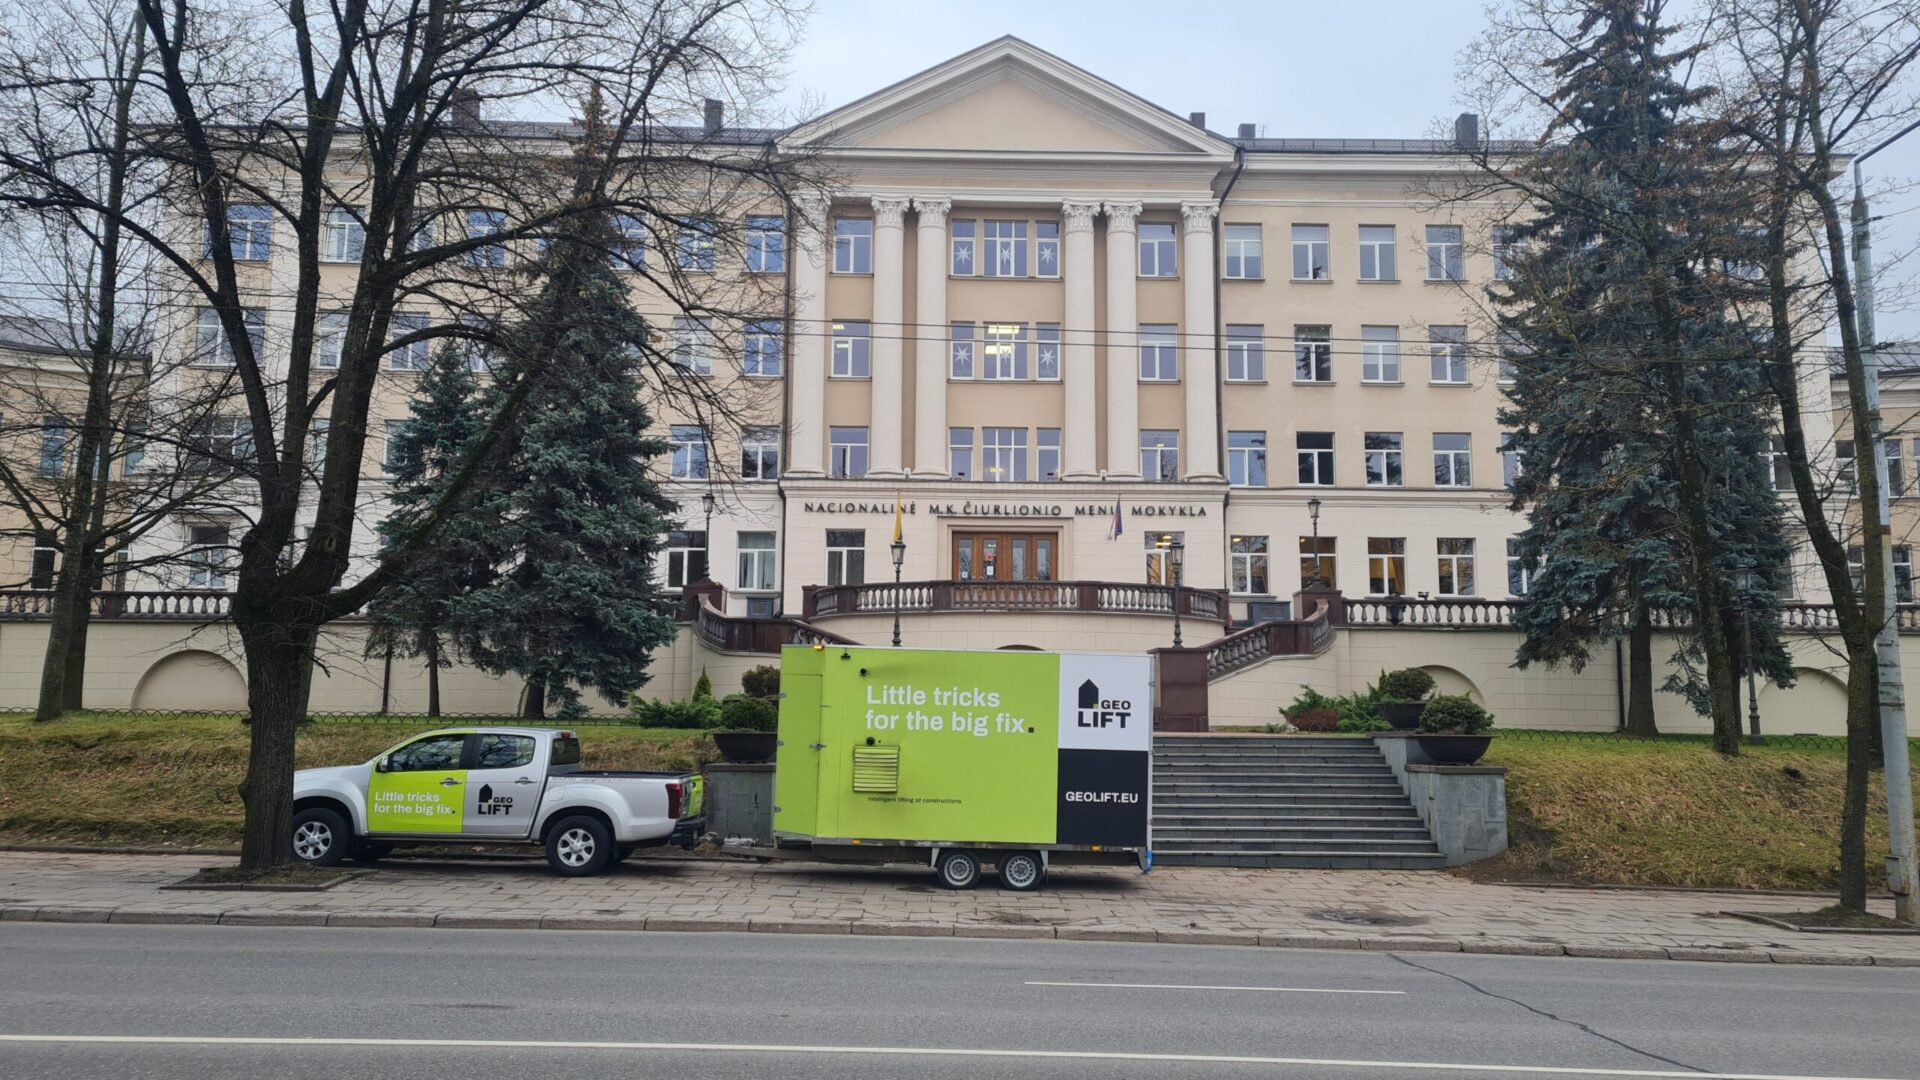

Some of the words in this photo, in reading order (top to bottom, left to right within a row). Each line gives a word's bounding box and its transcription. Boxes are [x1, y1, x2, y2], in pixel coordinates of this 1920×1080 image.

[929, 503, 957, 515] M.K.
[963, 501, 1062, 516] ČIURLIONIO
[1131, 505, 1207, 517] MOKYKLA
[867, 685, 926, 705] Little
[934, 687, 1000, 707] tricks
[1101, 700, 1131, 710] GEO
[865, 709, 899, 730] for
[906, 711, 943, 731] the
[952, 712, 989, 737] big
[1078, 711, 1131, 728] LIFT
[375, 792, 404, 802] Little
[408, 792, 440, 802] tricks
[1065, 791, 1139, 803] GEOLIFT.EU
[374, 804, 391, 813] for
[394, 804, 412, 814] the
[415, 804, 434, 816] big
[478, 804, 513, 815] LIFT
